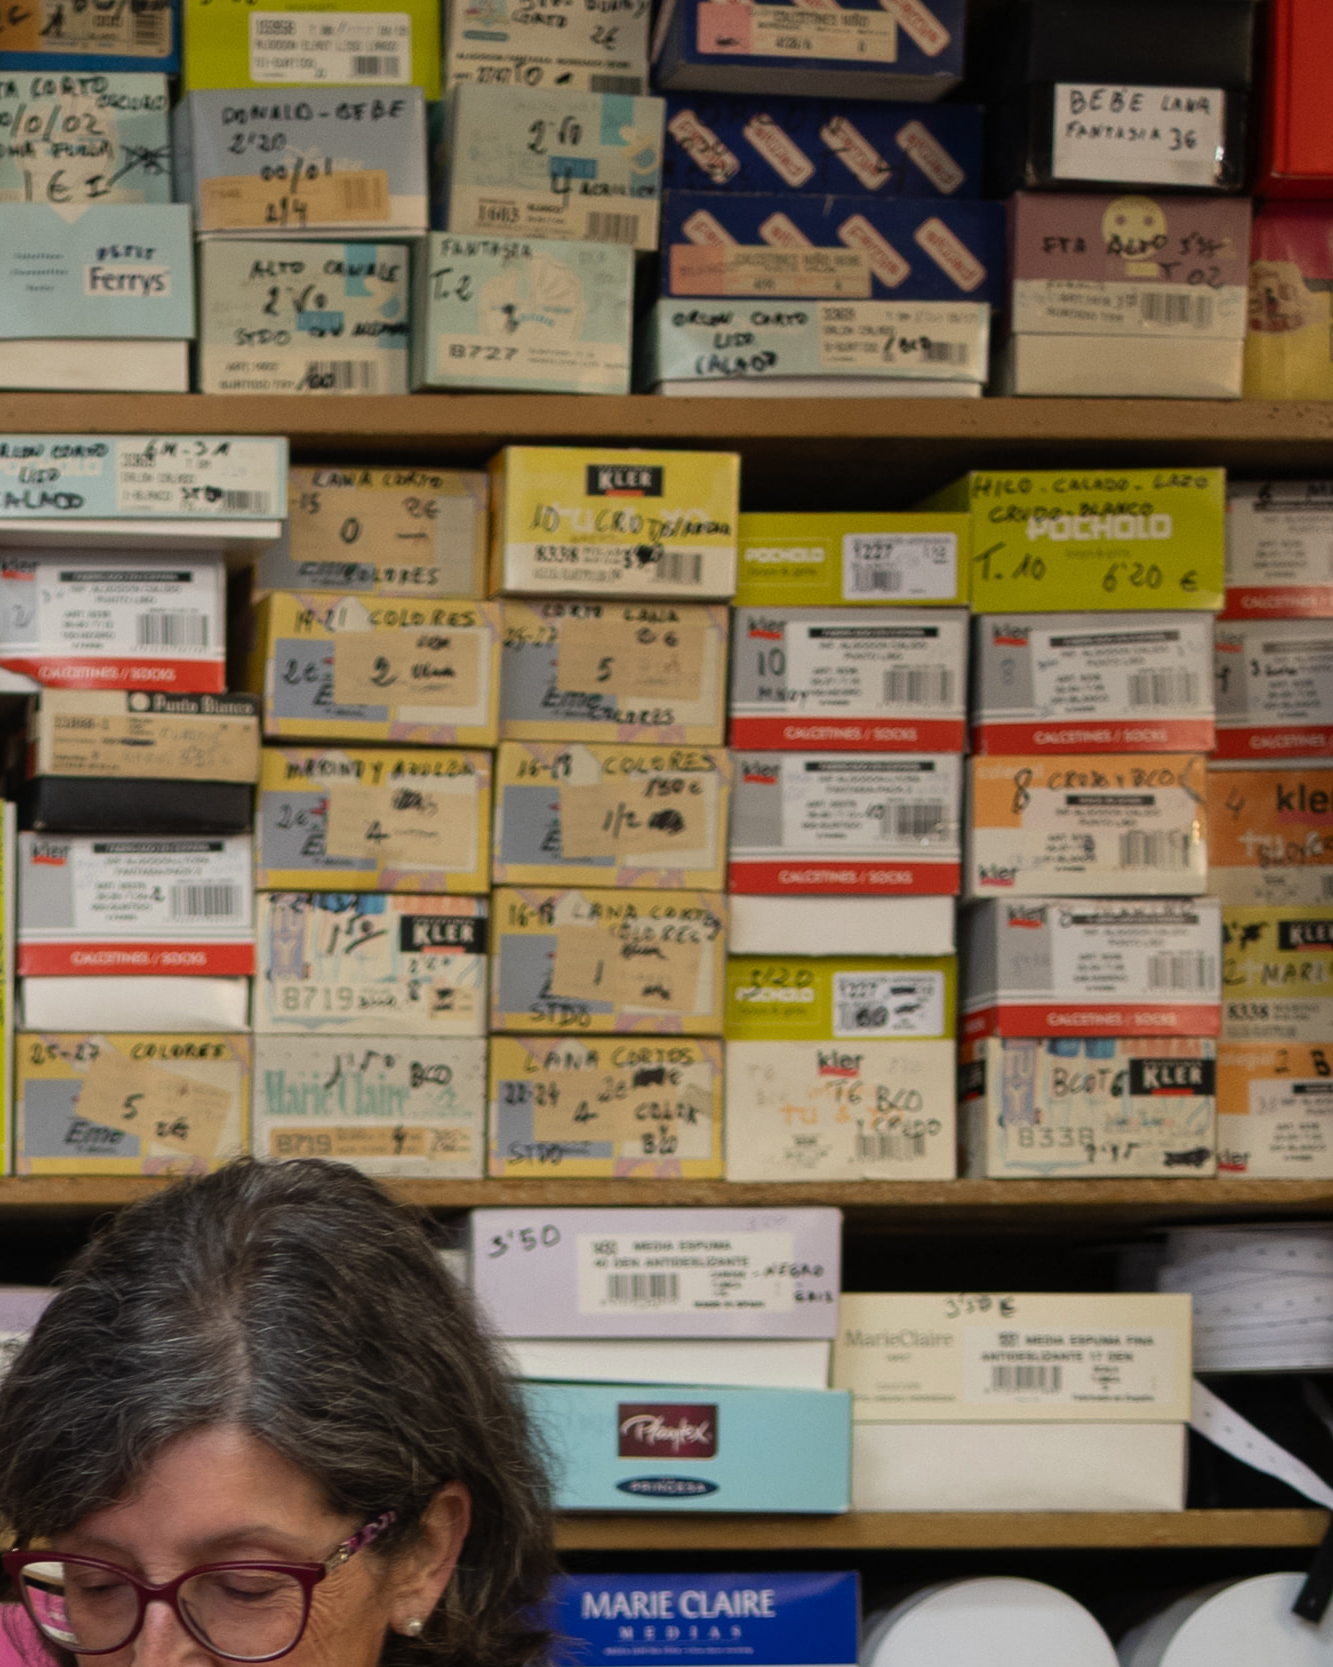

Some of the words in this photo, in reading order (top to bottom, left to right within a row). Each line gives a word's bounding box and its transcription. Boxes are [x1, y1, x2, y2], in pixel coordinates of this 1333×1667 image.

[88, 267, 166, 297] Ferrys
[448, 342, 519, 361] 8727
[598, 468, 653, 489] KLER
[1026, 514, 1172, 541] POCHOLO
[783, 727, 862, 741] CALCETINES
[874, 728, 918, 741] SOCKS
[1034, 729, 1112, 745] CALCETINES
[1123, 730, 1168, 742] SOCKS
[778, 870, 856, 885] CALCETINES
[868, 870, 913, 885] SOCKS
[413, 922, 474, 946] KLER
[70, 951, 148, 966] CALCETINES
[161, 952, 206, 965] SOCKS
[282, 985, 354, 1012] 8719
[1047, 1013, 1122, 1026] CALCETINES
[1134, 1014, 1176, 1026] SOCKS
[817, 1049, 865, 1070] kler
[1143, 1065, 1202, 1087] KLER
[264, 1069, 331, 1117] Marie
[340, 1069, 407, 1117] Claire
[678, 1240, 731, 1251] ESPUMA
[645, 1255, 749, 1267] ANTIDESLIZANTE
[1024, 1333, 1065, 1345] MEDIA
[1069, 1334, 1121, 1346] ESPUMA
[1126, 1335, 1154, 1346] FINA
[980, 1350, 1083, 1362] ANTIDESLIZANTE
[1107, 1352, 1133, 1362] DEN
[620, 1415, 713, 1455] Playtex
[582, 1591, 673, 1619] MARIE
[679, 1589, 776, 1619] CLAIRE
[618, 1625, 742, 1641] MEDIAS
